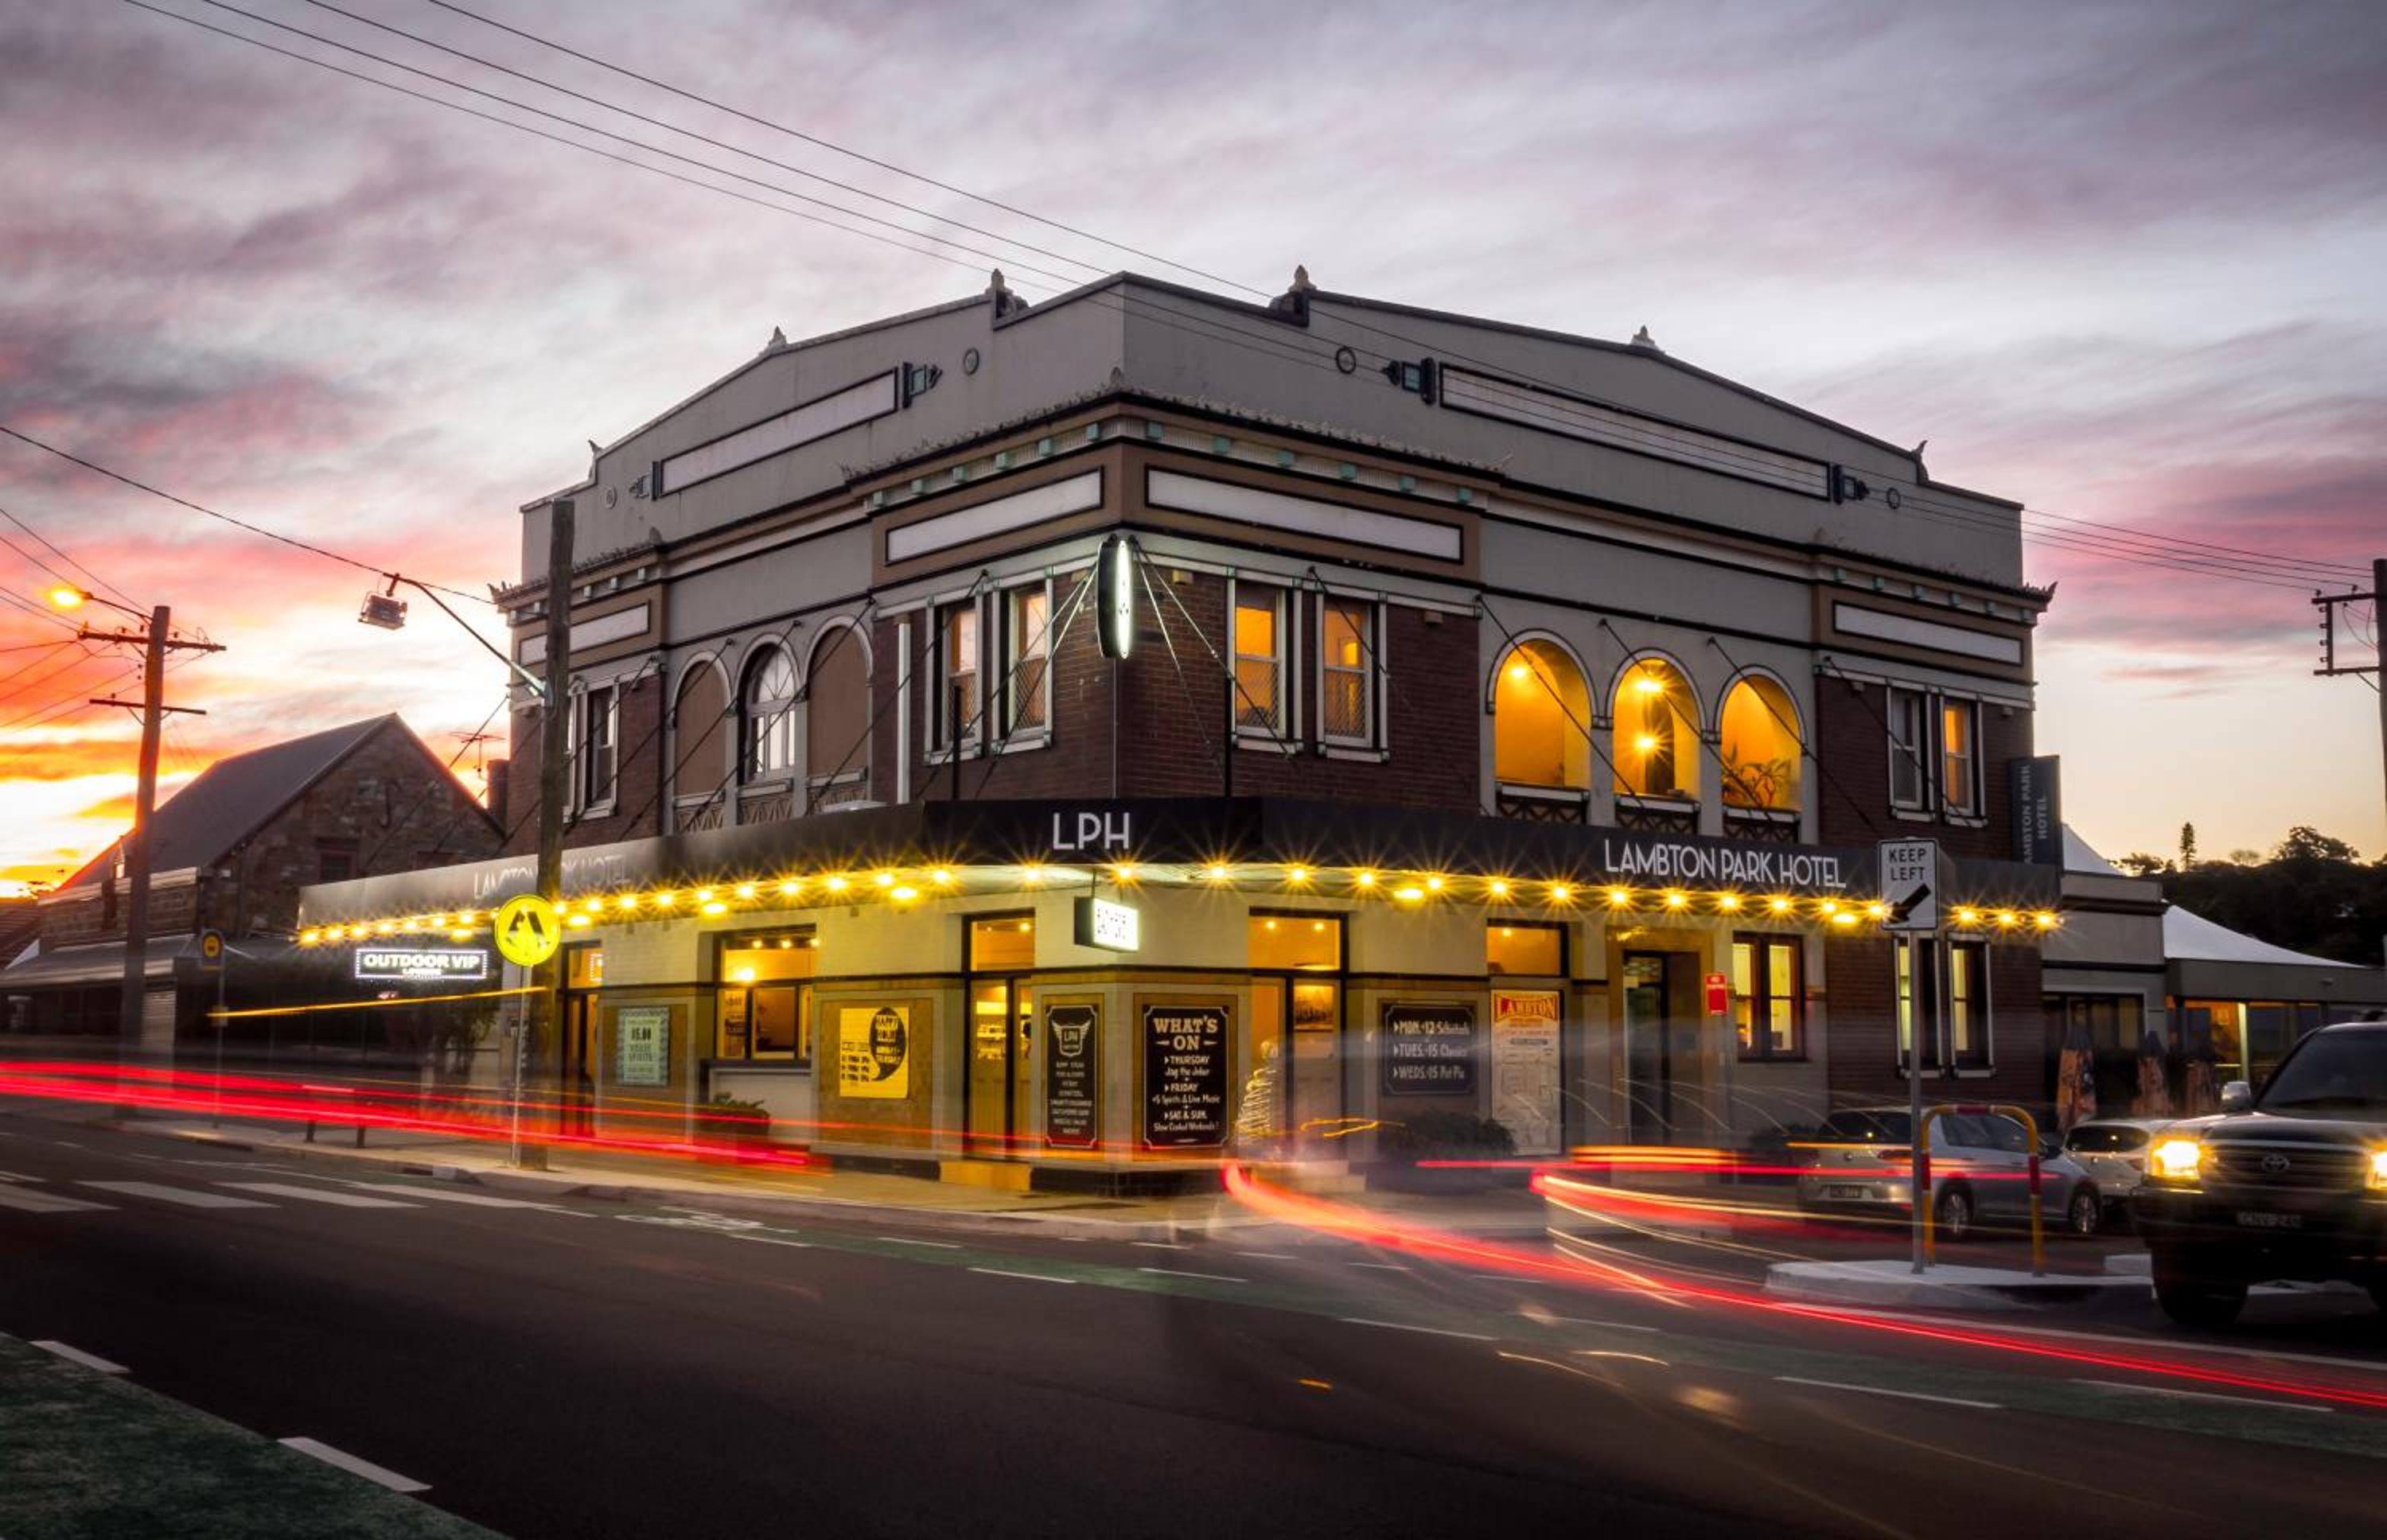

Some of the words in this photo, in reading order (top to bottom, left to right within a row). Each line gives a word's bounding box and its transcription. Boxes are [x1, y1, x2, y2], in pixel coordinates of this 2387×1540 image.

[2021, 764, 2031, 801] PARK
[2037, 795, 2048, 839] HOTEL
[1053, 811, 1130, 850] LPH
[2023, 804, 2033, 865] AMBTON
[1604, 838, 1716, 879] LAMBTON
[1720, 848, 1776, 884] PARK
[1778, 853, 1847, 889] HOTEL
[1889, 848, 1926, 863] KEEP
[1891, 866, 1925, 881] LEFT
[364, 954, 450, 968] OUTDOOR
[451, 955, 480, 969] VIP
[1153, 1015, 1218, 1033] WHAT'S
[1174, 1035, 1200, 1051] ON
[1170, 1056, 1210, 1065] THURSDAY
[1170, 1083, 1199, 1092] FRIDAY
